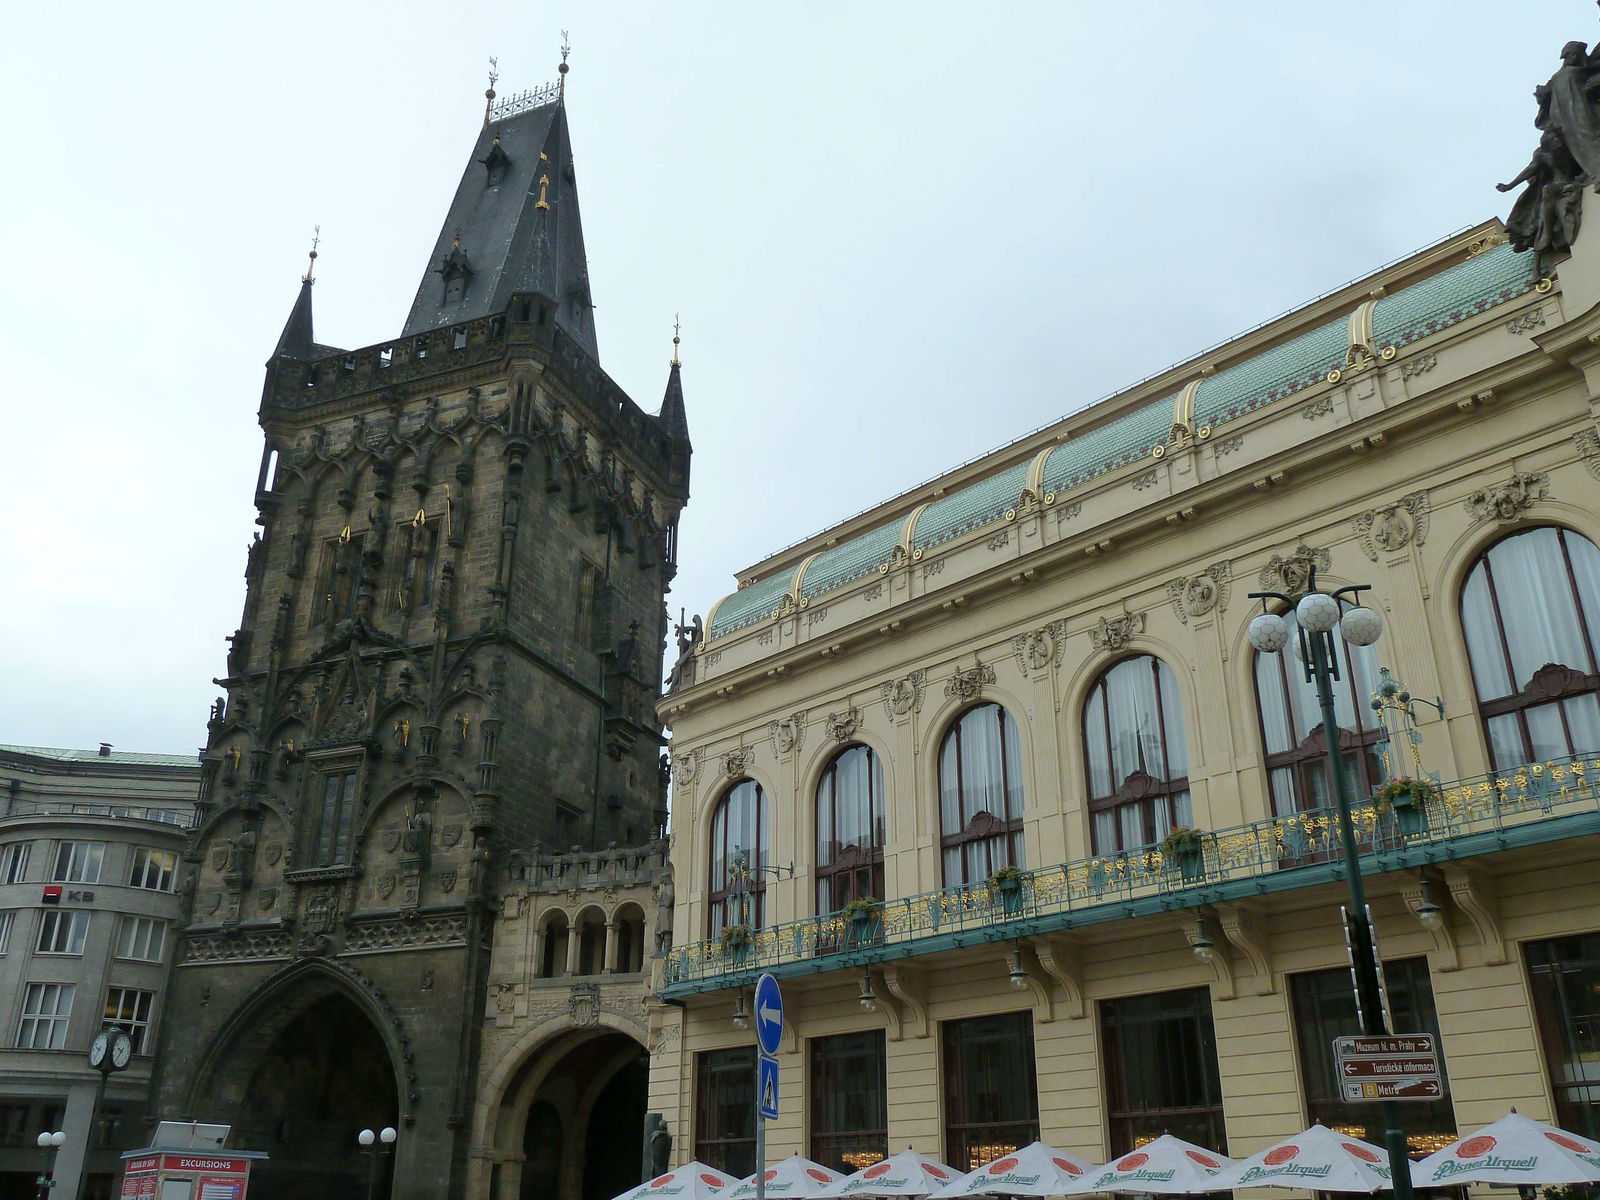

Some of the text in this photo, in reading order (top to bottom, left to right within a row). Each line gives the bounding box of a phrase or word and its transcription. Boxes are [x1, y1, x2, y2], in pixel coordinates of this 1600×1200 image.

[68, 890, 94, 902] KB
[1355, 1041, 1380, 1052] Muzeum
[1398, 1040, 1415, 1053] Prahy
[1372, 1061, 1435, 1073] Turistické informace
[1366, 1084, 1400, 1095] B Metro
[180, 1159, 231, 1169] EXCURSIONS
[1432, 1155, 1538, 1181] Pilsner Urquell
[1004, 1173, 1041, 1185] Urquell
[1092, 1172, 1136, 1189] Pilsner
[1135, 1169, 1176, 1182] Urquell
[1238, 1166, 1287, 1184] Pilsner
[1286, 1163, 1332, 1178] Urquell
